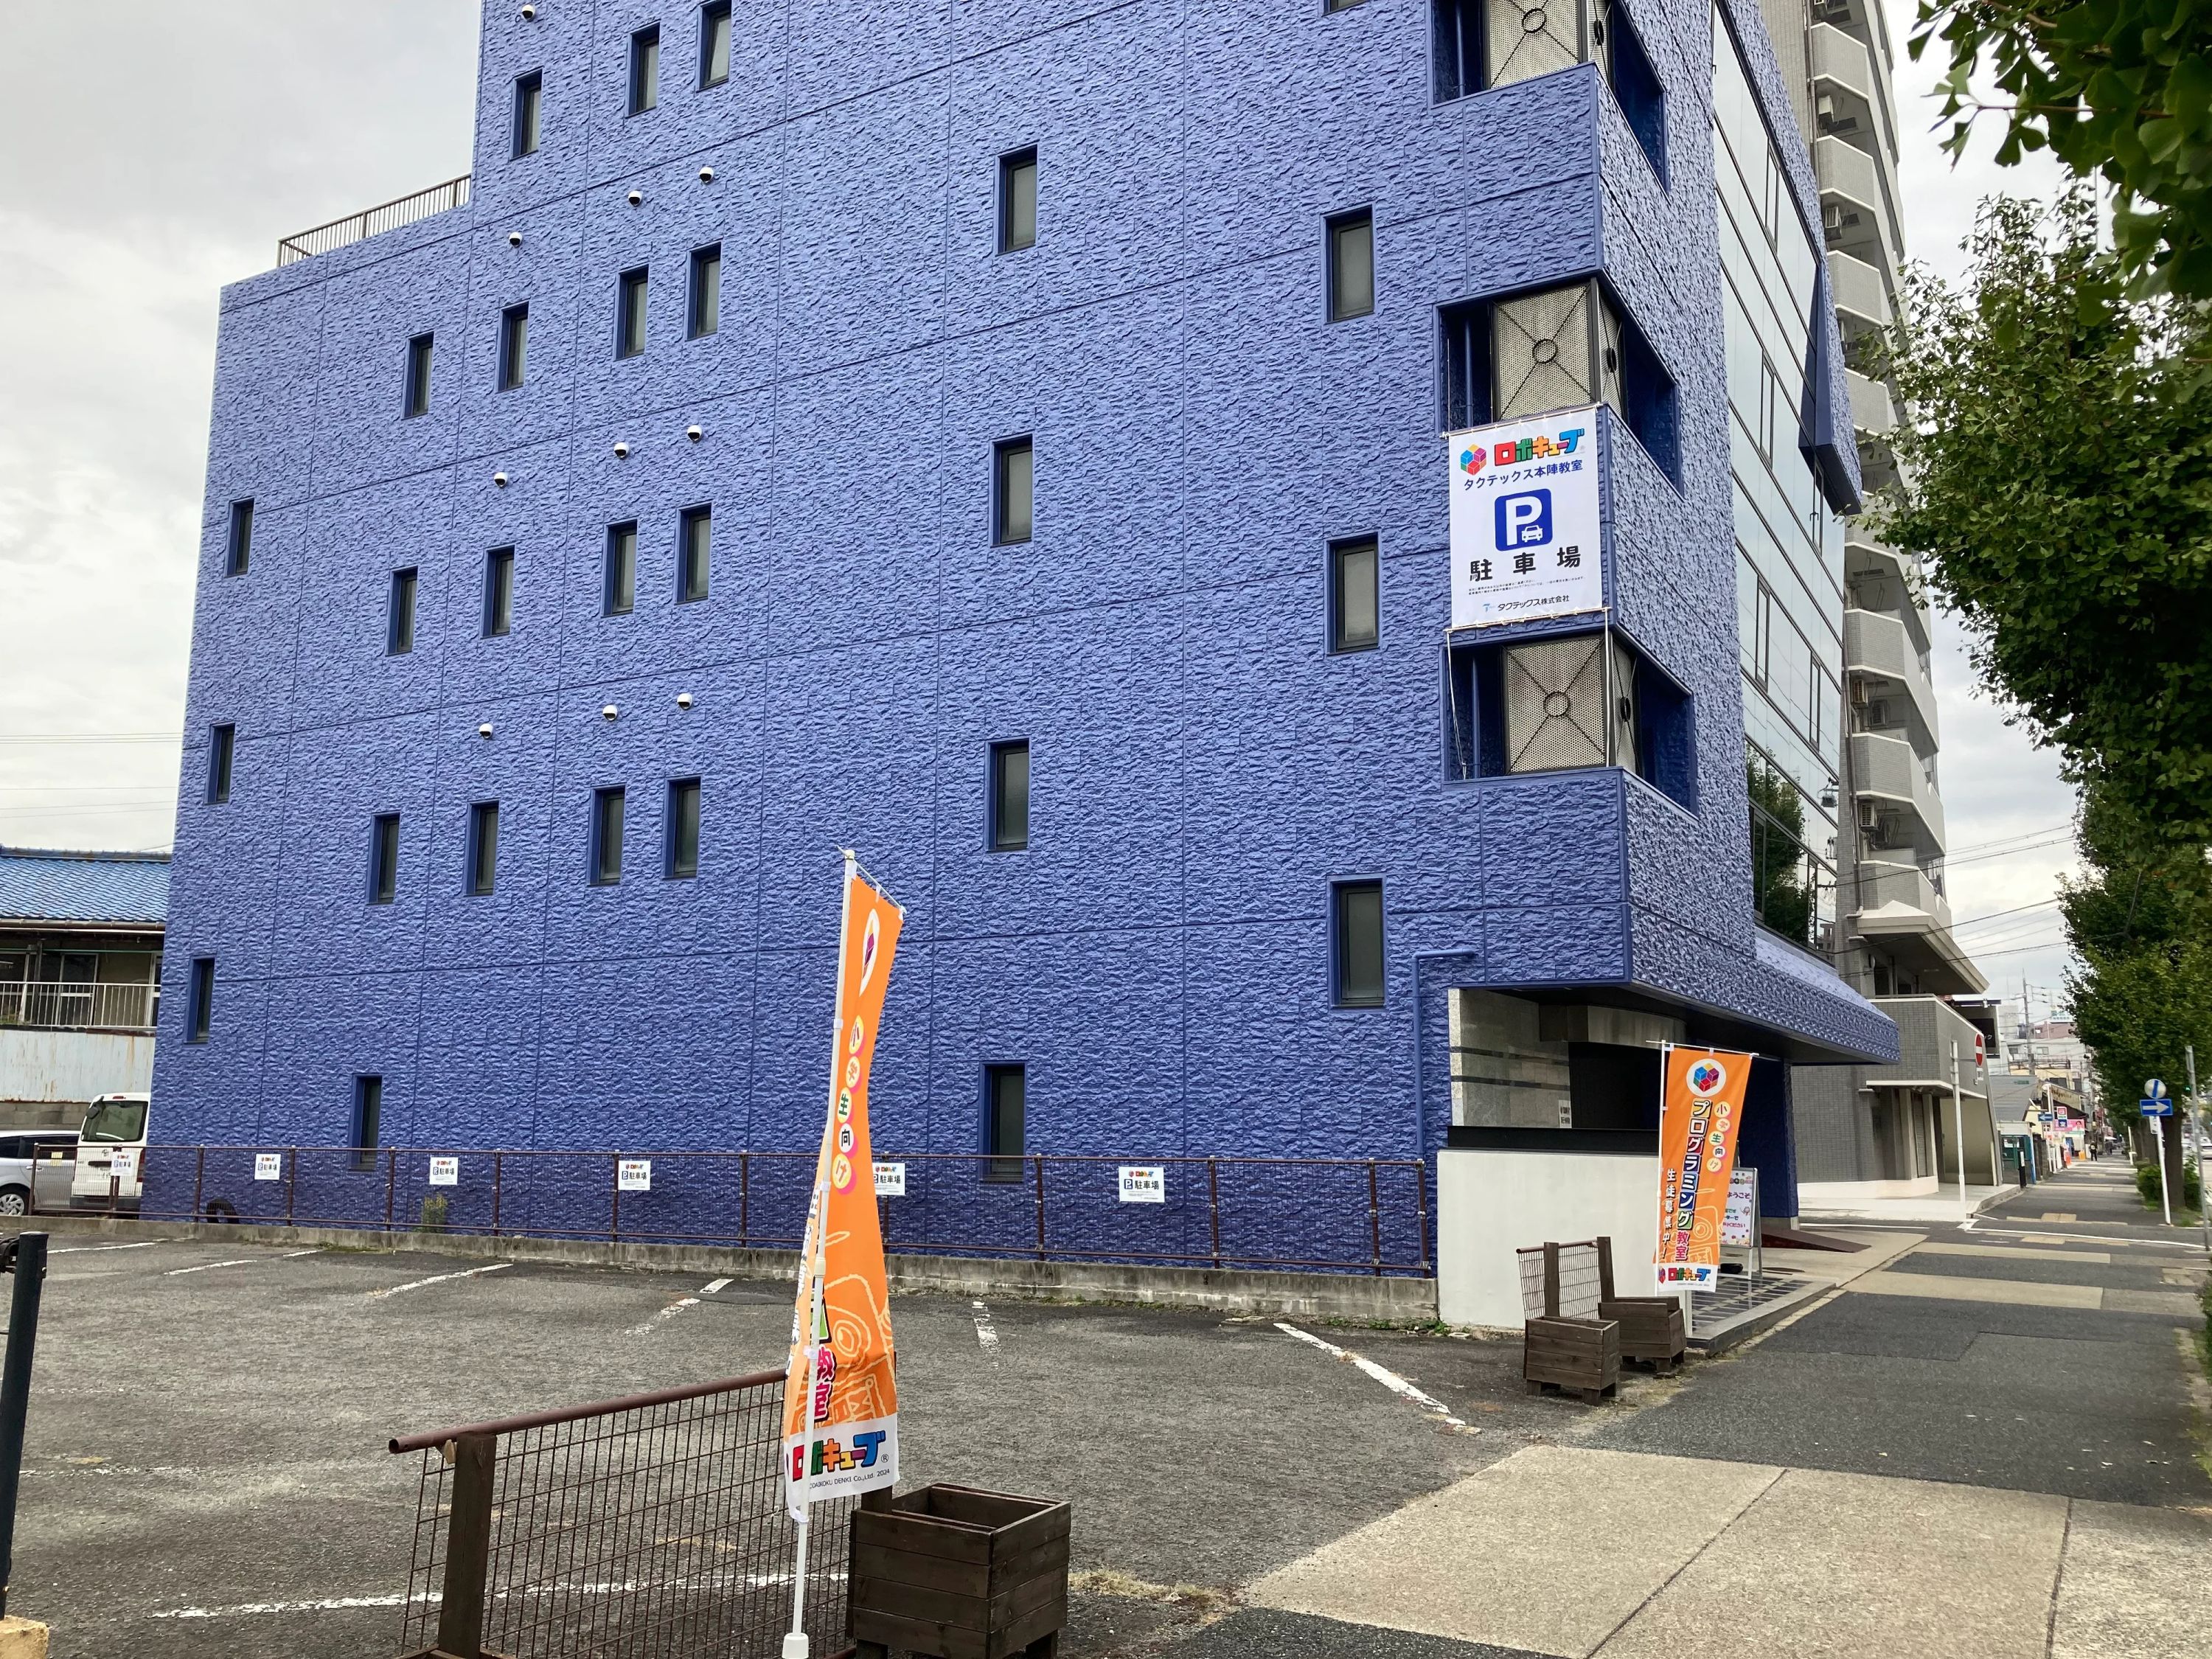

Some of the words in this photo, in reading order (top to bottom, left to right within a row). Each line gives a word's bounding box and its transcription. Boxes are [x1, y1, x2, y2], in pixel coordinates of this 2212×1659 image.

[1494, 428, 1585, 466] ロボキューブ
[1464, 459, 1583, 490] タクテックス本陣教室
[1505, 495, 1543, 546] P
[1470, 546, 1581, 582] 駐車場
[1498, 594, 1570, 612] タクテックス株式会社
[835, 1020, 862, 1184] 小学生向け
[1709, 1103, 1729, 1171] 小学生向け
[880, 1175, 900, 1183] 駐車場
[1135, 1180, 1159, 1189] 駐車場
[1674, 1099, 1712, 1262] プログラミング教室
[1669, 1267, 1711, 1281] ロボキューブ
[834, 1477, 852, 1485] DENKI
[877, 1468, 890, 1477] 2024
